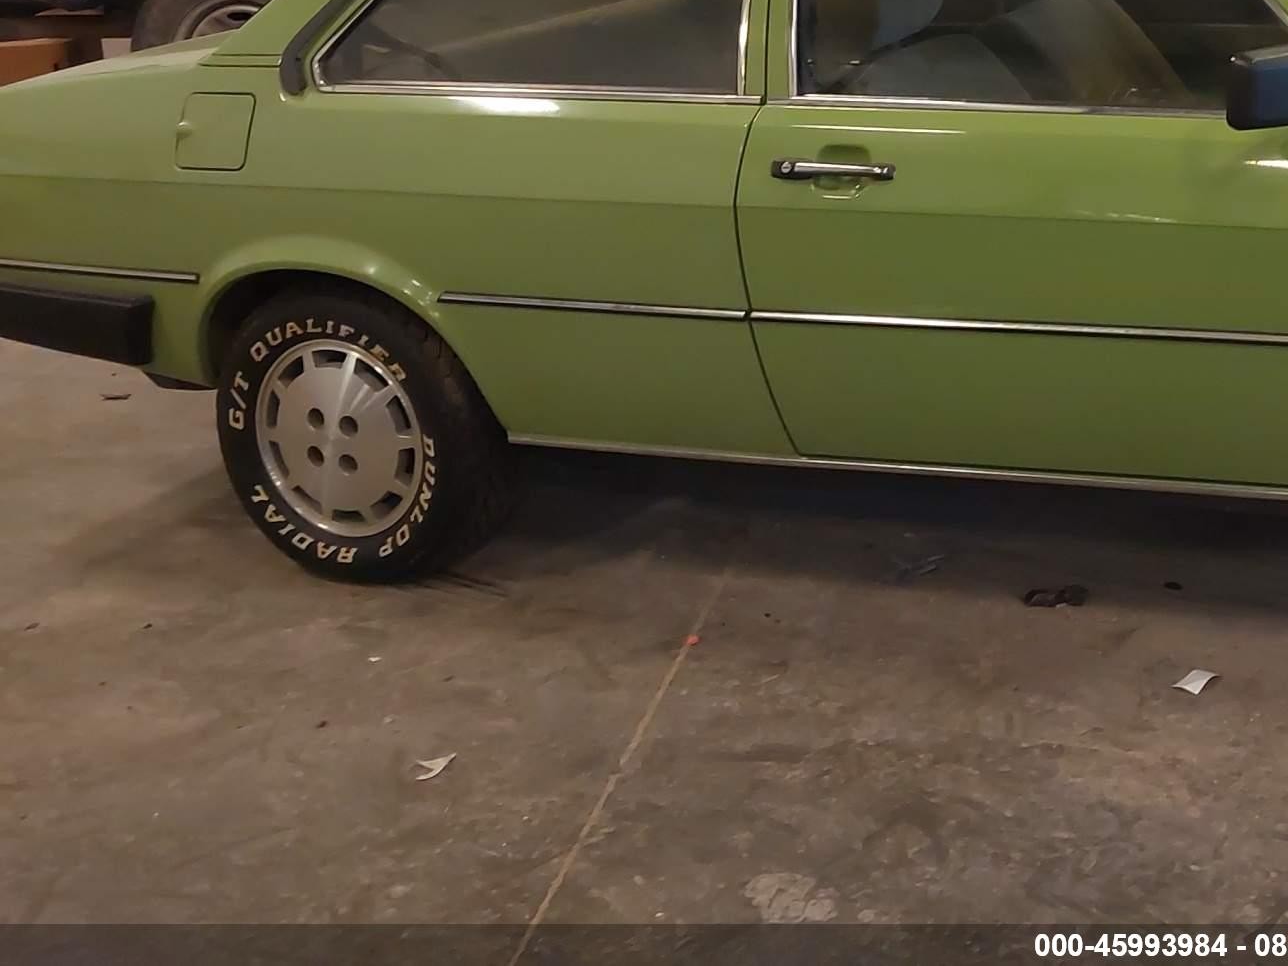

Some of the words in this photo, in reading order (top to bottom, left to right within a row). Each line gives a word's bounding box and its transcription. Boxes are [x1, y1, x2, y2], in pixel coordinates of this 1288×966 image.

[250, 318, 407, 382] QUALIFIER
[251, 484, 359, 563] RADIAL
[378, 435, 436, 558] DUNLOP
